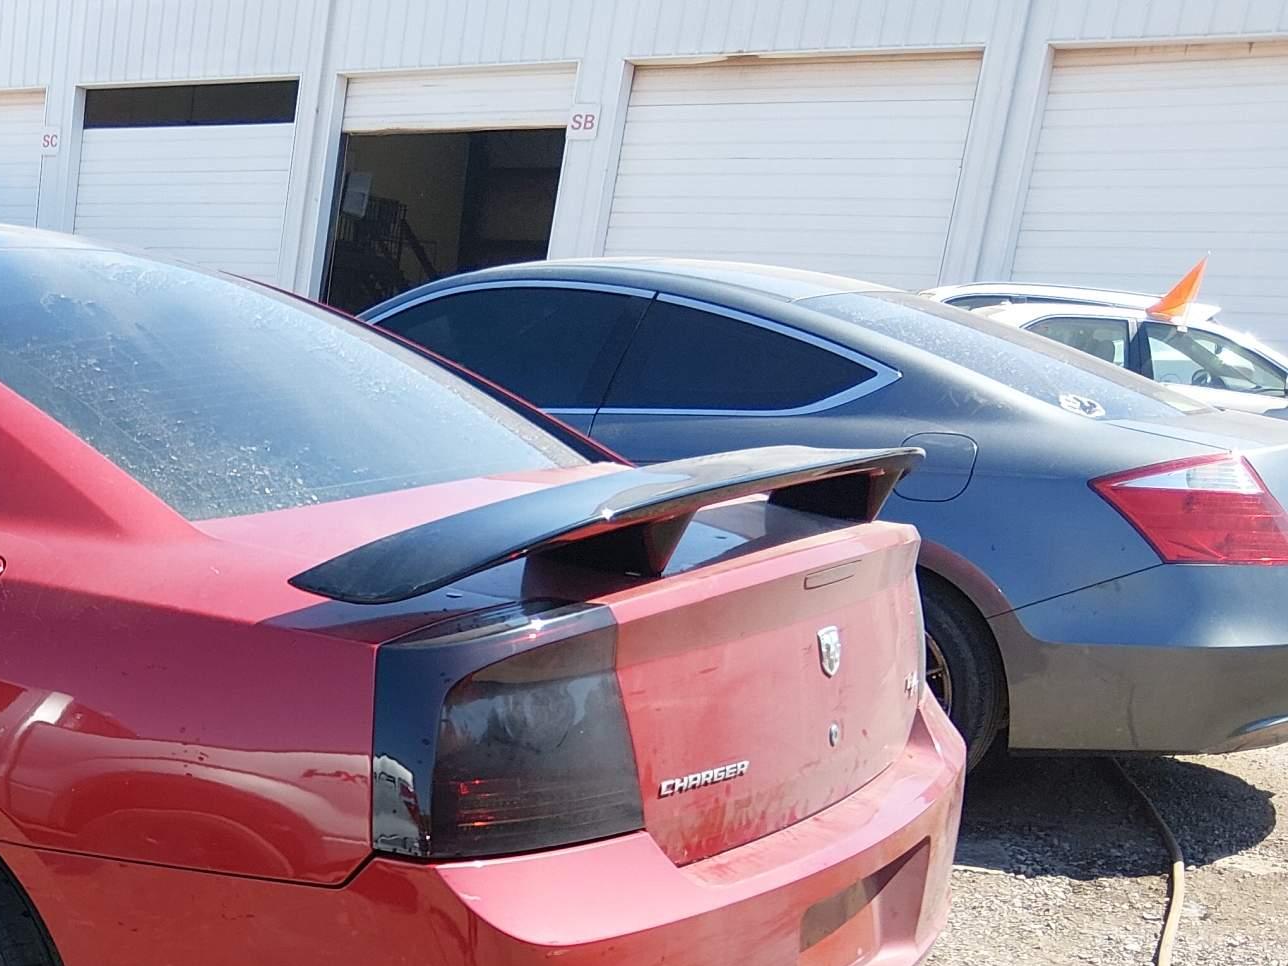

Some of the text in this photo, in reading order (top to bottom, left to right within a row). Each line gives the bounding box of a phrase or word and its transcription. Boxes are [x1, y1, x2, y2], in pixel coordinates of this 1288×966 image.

[571, 114, 595, 130] SB
[42, 134, 58, 148] SC
[659, 760, 750, 797] CHARGER
